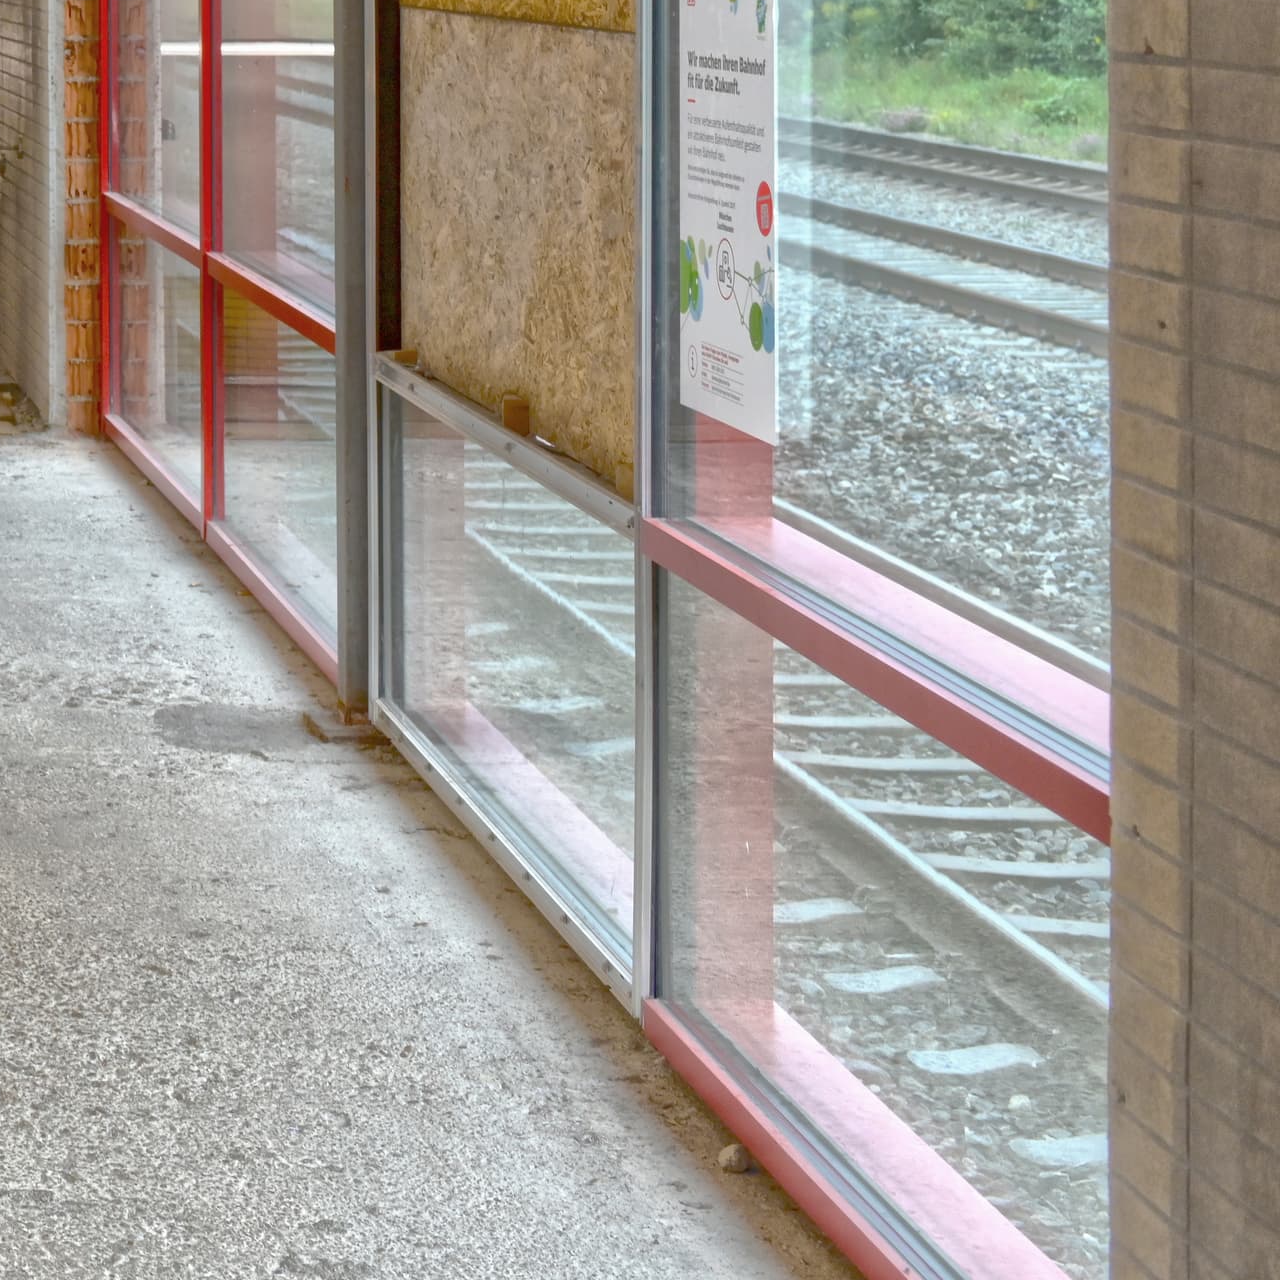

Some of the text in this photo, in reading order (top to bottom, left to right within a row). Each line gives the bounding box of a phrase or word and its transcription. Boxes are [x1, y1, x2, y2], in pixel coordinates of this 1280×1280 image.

[687, 50, 698, 68] Wir
[699, 53, 721, 71] machen
[739, 56, 766, 76] Bahnhof
[695, 73, 703, 90] für
[704, 74, 713, 92] die
[714, 76, 740, 95] Zukunft.
